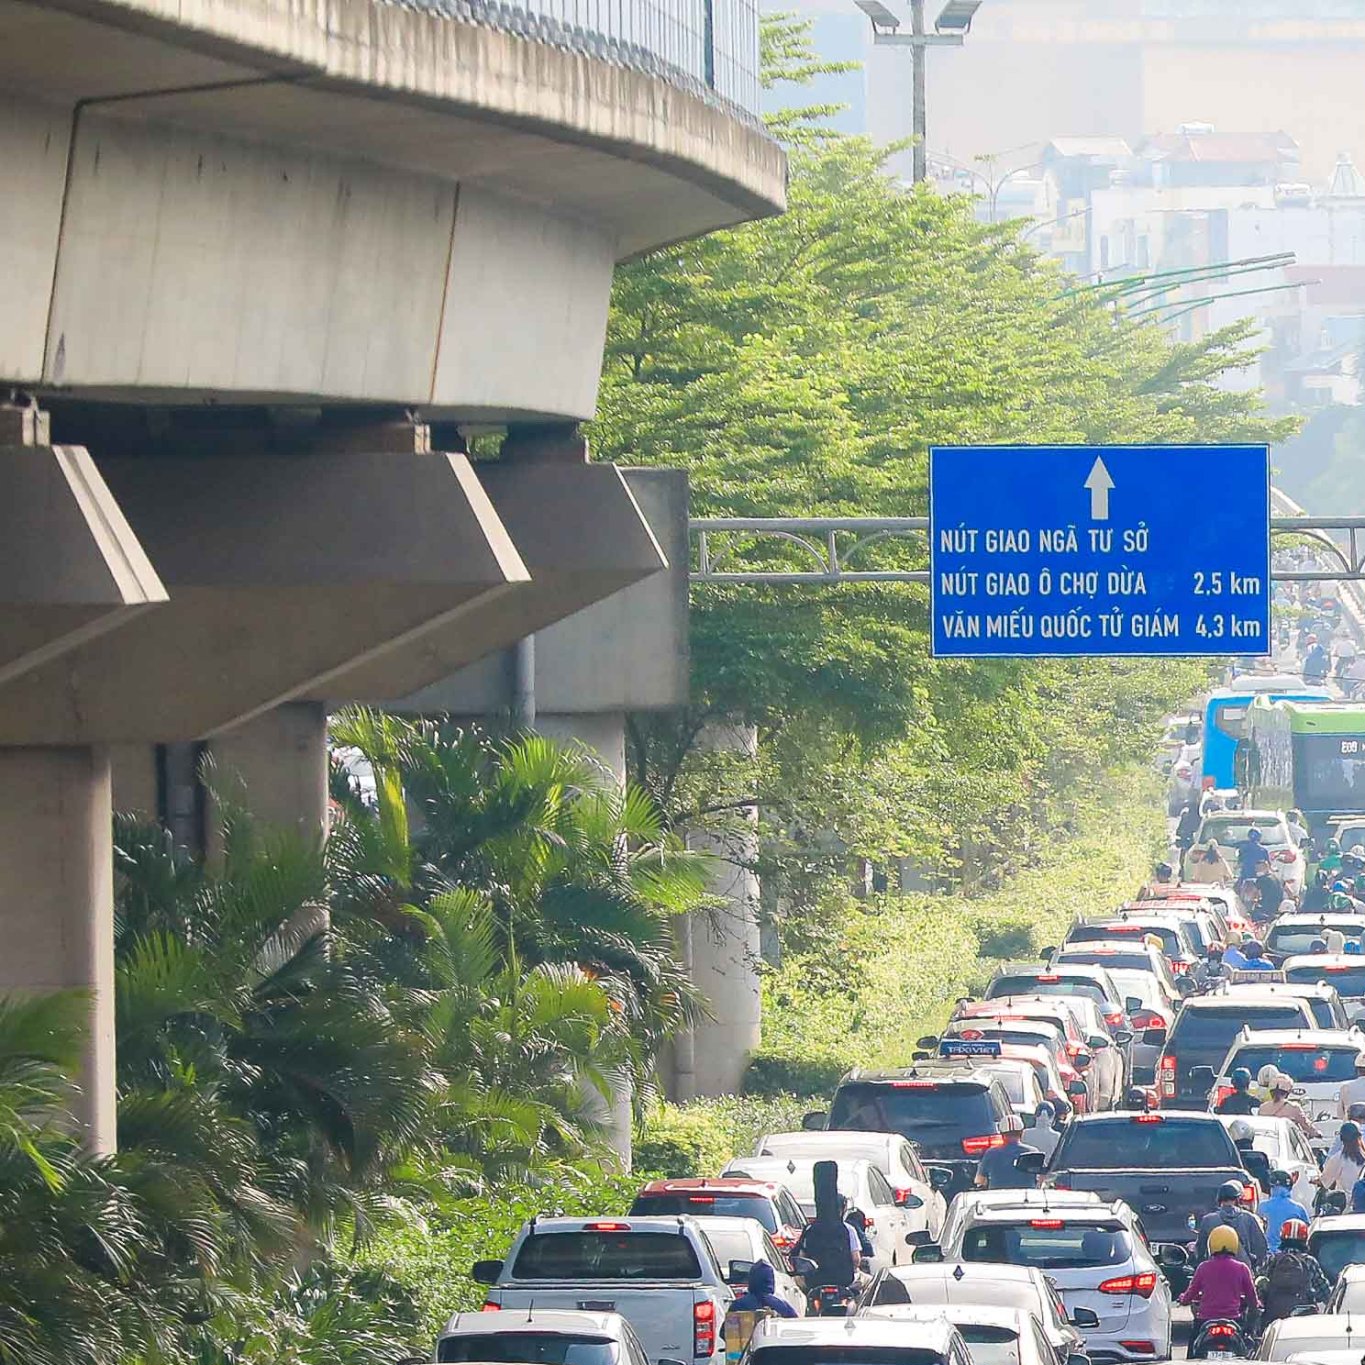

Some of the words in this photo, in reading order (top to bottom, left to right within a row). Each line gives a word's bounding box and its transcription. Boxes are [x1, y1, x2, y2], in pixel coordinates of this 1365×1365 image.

[941, 524, 976, 552] NÚT
[985, 530, 1030, 553] GIAO
[1039, 524, 1079, 552] NGÃ
[1088, 528, 1114, 553] TƯ
[1123, 521, 1150, 552] SỞ
[941, 567, 976, 596] NÚT
[985, 573, 1029, 596] GIAO
[1038, 567, 1052, 596] Ô
[1060, 572, 1098, 600] CHỢ
[1107, 567, 1147, 596] DỪA
[1231, 571, 1260, 595] km
[942, 611, 980, 638] VĂN
[985, 606, 1034, 638] MIẾU
[1040, 606, 1091, 639] QUỐC
[1099, 607, 1124, 637] TỬ
[1131, 607, 1180, 638] GIÁM
[1231, 613, 1260, 637] km
